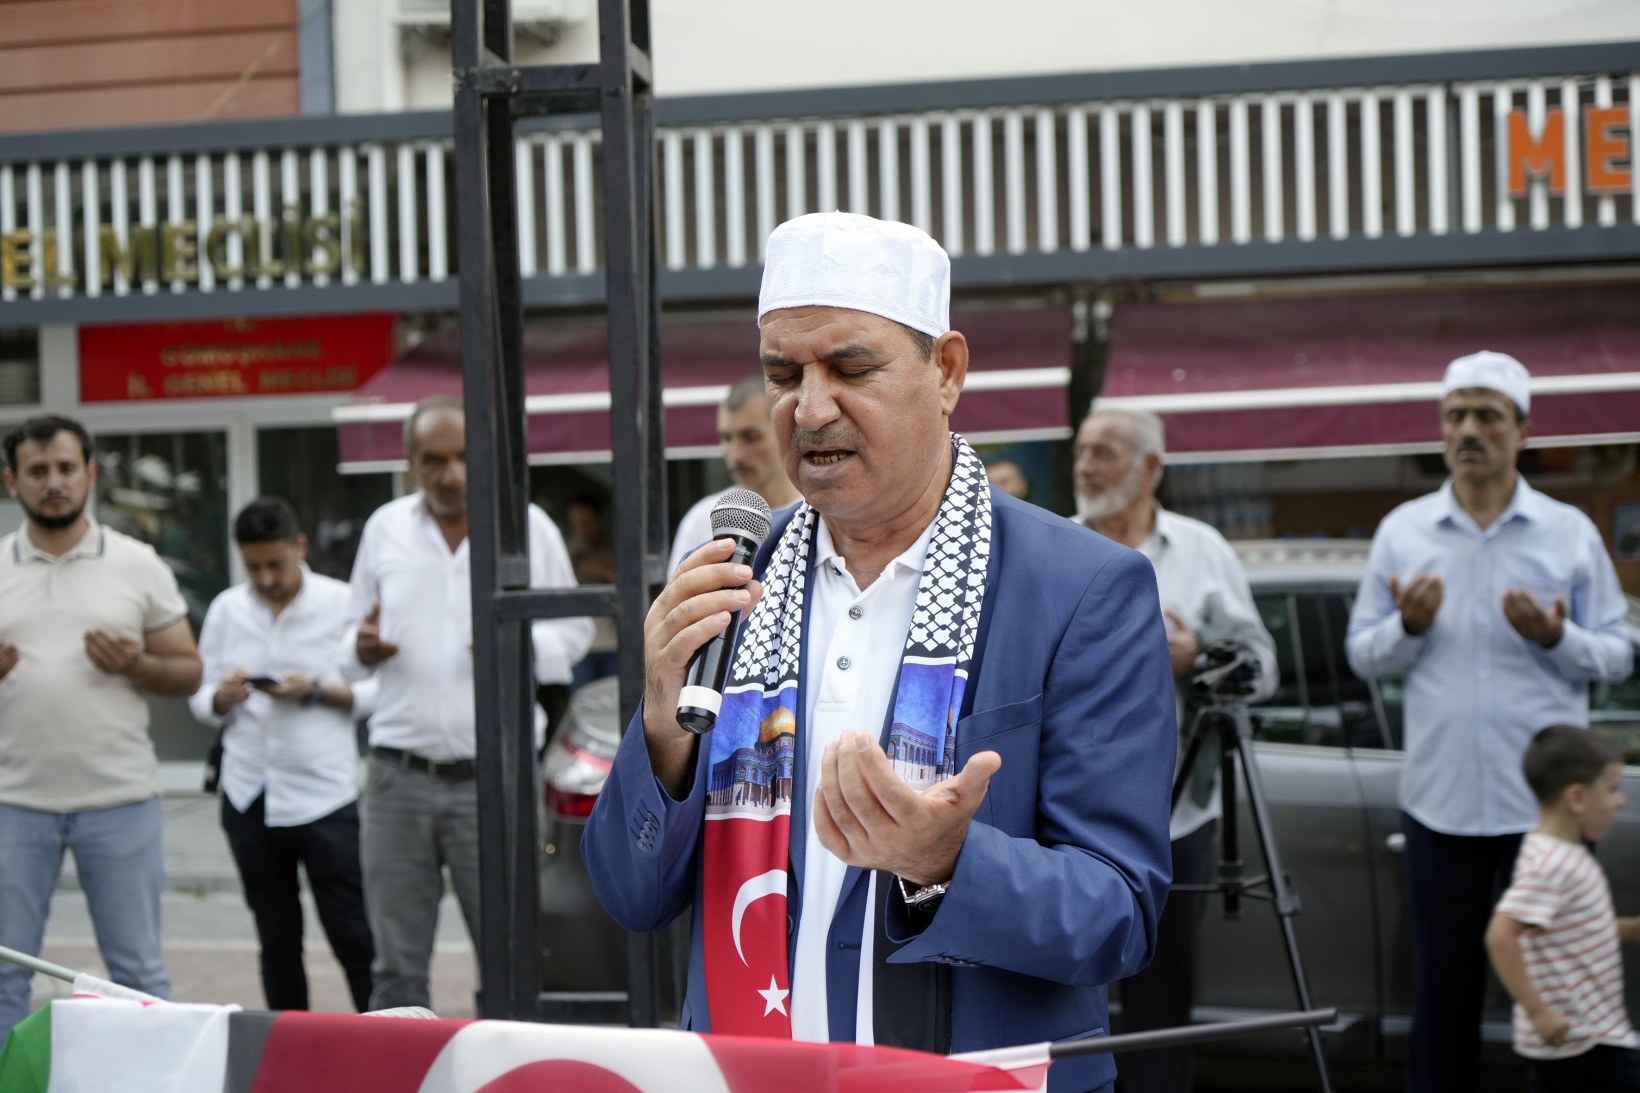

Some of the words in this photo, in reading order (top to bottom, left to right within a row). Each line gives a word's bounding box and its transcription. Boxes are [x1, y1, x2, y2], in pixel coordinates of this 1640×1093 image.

[1506, 104, 1632, 197] ME
[1, 226, 78, 289] EL
[163, 369, 249, 396] GENEL
